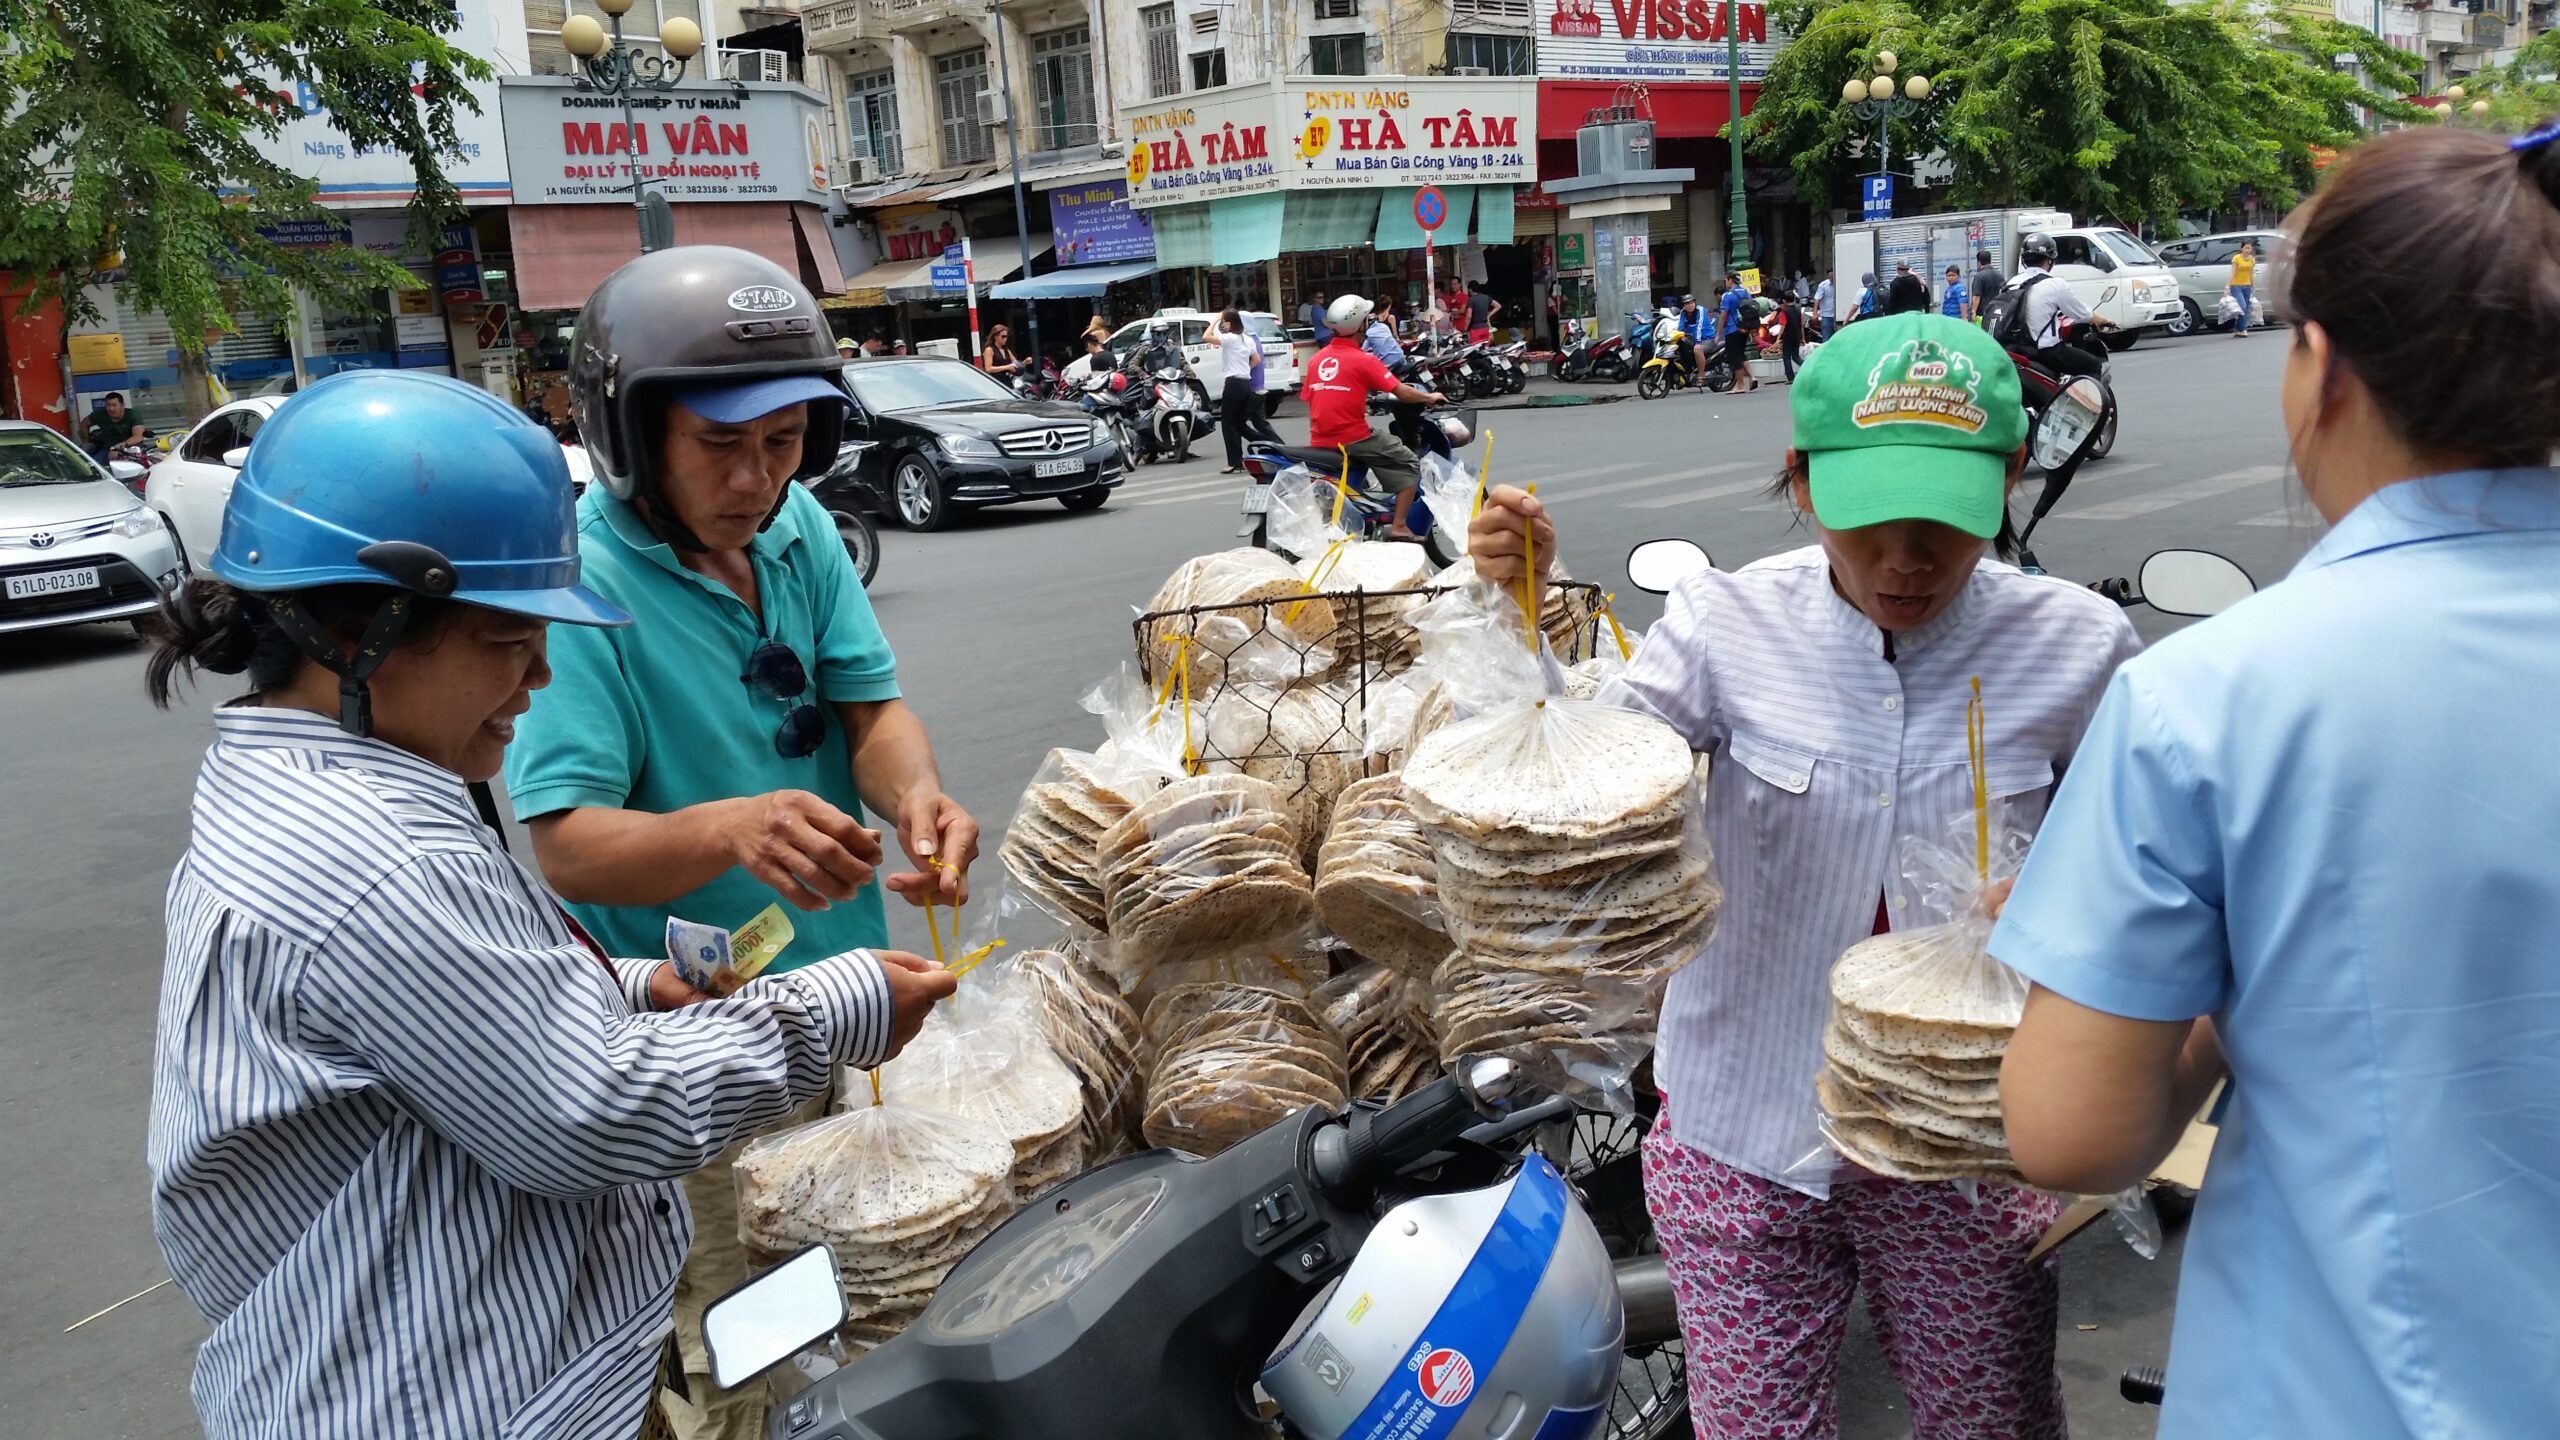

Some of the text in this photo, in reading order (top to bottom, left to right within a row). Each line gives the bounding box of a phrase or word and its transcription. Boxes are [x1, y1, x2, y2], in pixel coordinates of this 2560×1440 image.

[1557, 20, 1598, 33] VISSAN
[1610, 0, 1767, 44] VISSAN
[561, 97, 615, 108] DOANH
[675, 98, 696, 109] TƯ
[700, 97, 741, 110] NHÂN
[1305, 87, 1410, 110] DNTN VÀNG
[1132, 107, 1196, 134] DNTN VÀNG
[1338, 108, 1518, 150] HÀ TÂM
[563, 115, 748, 155] MAI VÂN
[1150, 121, 1268, 172] HÀ TÂM
[1310, 127, 1325, 146] HT
[304, 140, 344, 158] Nâng
[564, 165, 593, 180] ĐẠI
[597, 161, 616, 177] LÝ
[657, 157, 686, 177] ĐỔI
[689, 165, 737, 180] NGOẠI
[740, 161, 760, 180] TỆ
[1336, 157, 1361, 170] Mua
[1364, 156, 1387, 169] Bán
[1391, 156, 1410, 169] Gia
[1413, 155, 1445, 170] Công
[1449, 154, 1478, 169] Vàng
[546, 187, 557, 196] 1A
[560, 184, 597, 195] NGUYỄN
[686, 185, 728, 194] 38231836
[738, 185, 778, 193] 38237630
[1151, 177, 1167, 190] Mua
[1168, 174, 1184, 187] Bán
[1185, 173, 1199, 185] Gia
[1200, 170, 1221, 184] Công
[1222, 167, 1242, 182] Vàng
[1306, 176, 1334, 184] NGUYỄN
[1872, 178, 1887, 197] P
[1058, 188, 1114, 206] Thu Minh
[732, 289, 790, 307] STAR
[1912, 366, 1944, 376] MILO
[1880, 384, 1967, 404] HÀNH TRÌNH
[1900, 398, 1949, 415] LƯỢNG
[1948, 404, 1985, 424] XANH
[13, 571, 94, 595] 61LD-023.08
[1408, 1341, 1432, 1372] SCB
[1438, 1353, 1459, 1380] BANK
[1395, 1398, 1424, 1431] SAIGON
[1410, 1406, 1437, 1436] NGÂN
